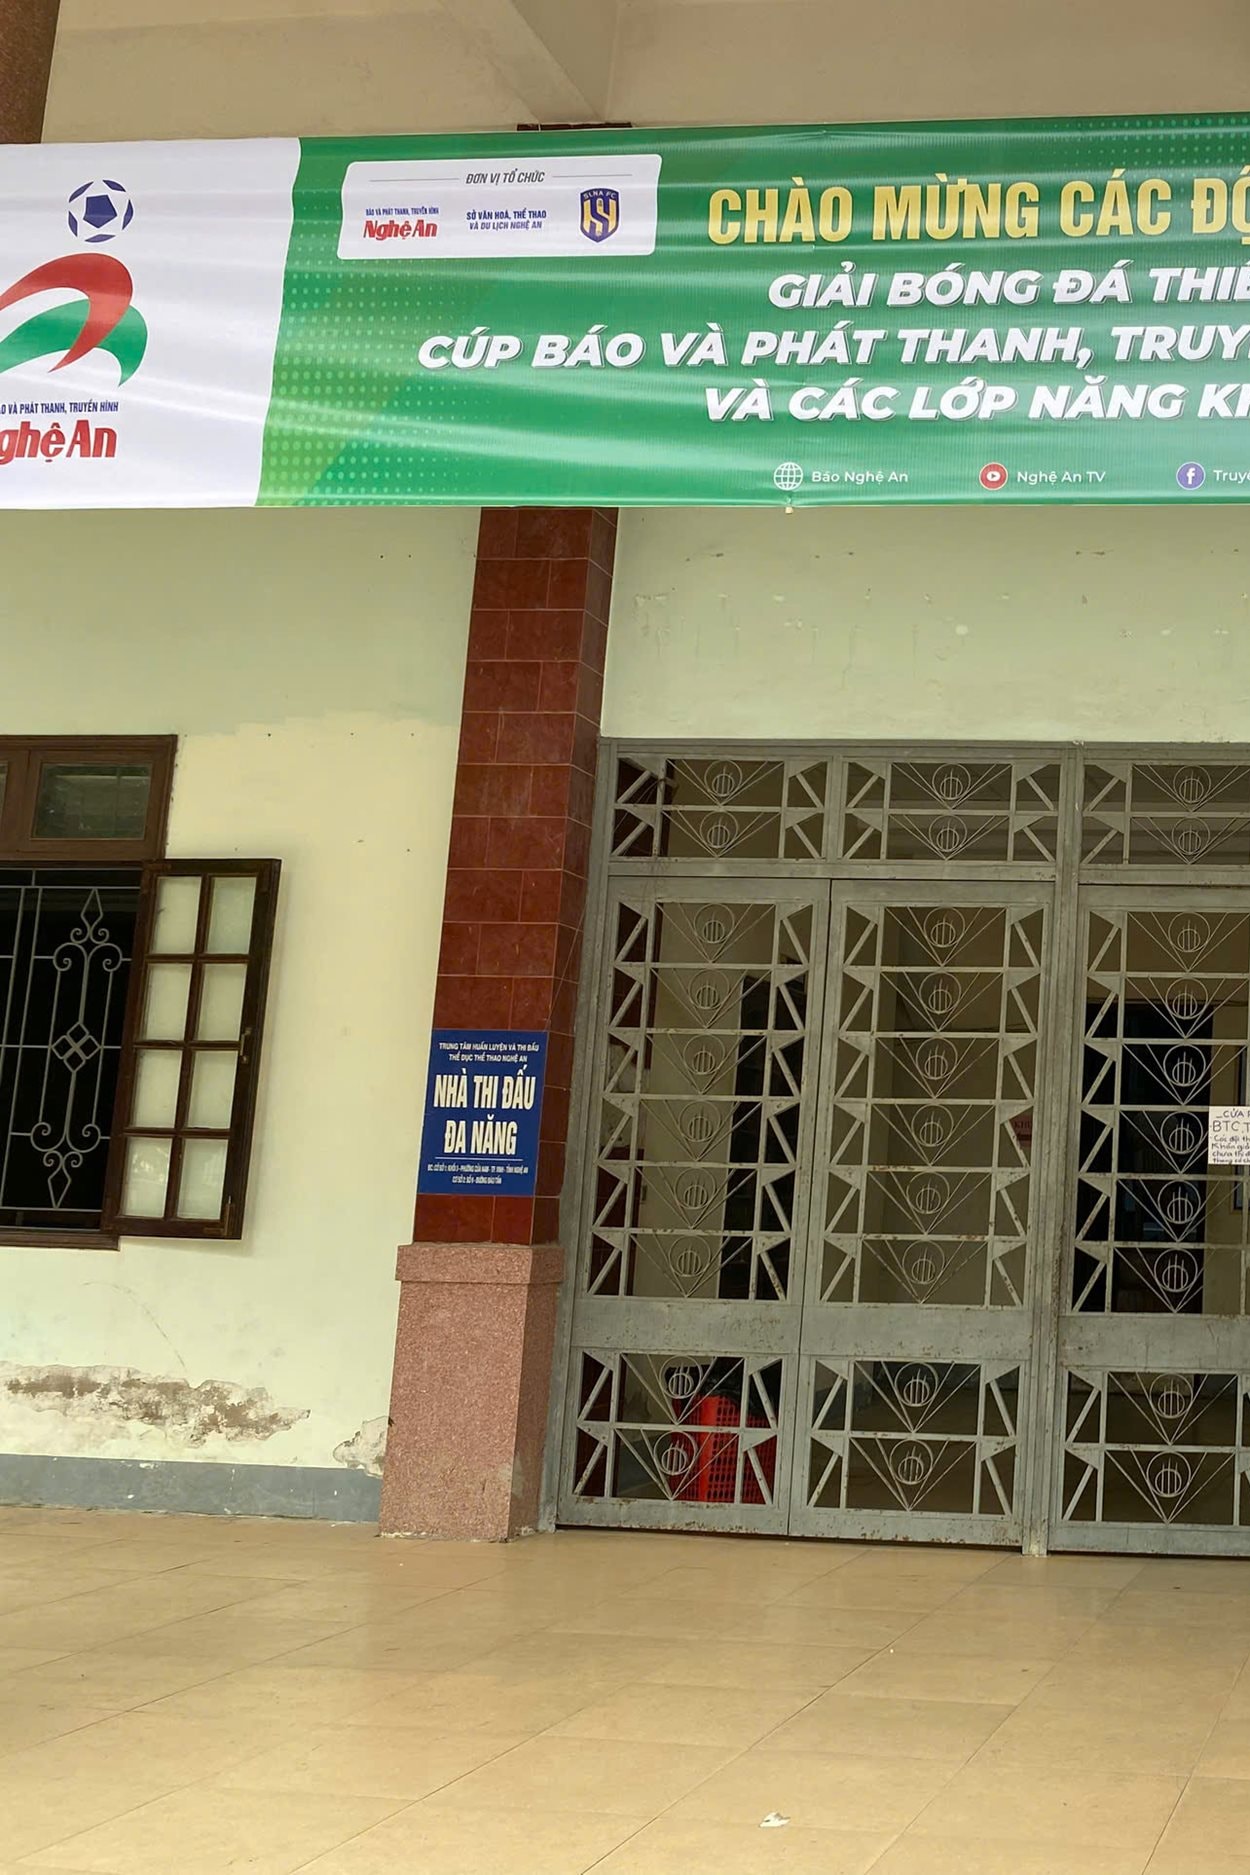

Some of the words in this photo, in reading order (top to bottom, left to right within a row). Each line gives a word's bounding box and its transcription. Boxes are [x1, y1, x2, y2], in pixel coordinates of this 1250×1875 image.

[466, 173, 488, 184] ĐƠN
[490, 173, 501, 186] VỊ
[503, 168, 518, 183] TỔ
[517, 170, 545, 183] CHỨC
[606, 191, 617, 199] FC
[466, 209, 476, 220] SỞ
[478, 210, 493, 219] VĂN
[528, 210, 547, 219] THAO
[708, 176, 853, 245] CHÀO
[872, 173, 1039, 240] MỪNG
[1060, 168, 1171, 237] CÁC
[469, 221, 479, 230] VÀ
[481, 222, 491, 230] DU
[492, 222, 508, 231] LỊCH
[510, 220, 530, 230] NGHỆ
[532, 221, 542, 229] AN
[767, 261, 879, 309] GIẢI
[886, 262, 1043, 307] BÓNG
[1052, 259, 1134, 304] ĐÁ
[418, 326, 524, 369] CÚP
[531, 324, 646, 368] BÁO
[660, 322, 728, 367] VÀ
[741, 320, 887, 365] PHÁT
[897, 326, 1094, 369] THANH,
[8, 402, 18, 414] VÀ
[20, 401, 38, 414] PHÁT
[69, 399, 98, 412] TRUYỀN
[100, 400, 119, 412] HÌNH
[704, 378, 774, 422] VÀ
[788, 377, 901, 421] CÁC
[908, 376, 1018, 421] LỚP
[1029, 375, 1188, 420] NĂNG
[66, 420, 117, 458] An
[844, 470, 884, 485] Nghệ
[888, 471, 909, 483] An
[1017, 470, 1057, 485] Nghệ
[1062, 471, 1082, 483] An
[1086, 471, 1106, 483] TV
[439, 1042, 458, 1050] TRUNG
[460, 1041, 471, 1050] TÂM
[473, 1041, 488, 1050] HUẤN
[489, 1042, 507, 1051] LUYỆN
[509, 1042, 516, 1051] VÀ
[502, 1053, 518, 1063] NGHỆ
[433, 1068, 468, 1108] NHÀ
[473, 1075, 499, 1109] THI
[501, 1064, 536, 1110] ĐẤU
[444, 1120, 466, 1154] ĐA
[470, 1114, 518, 1155] NĂNG
